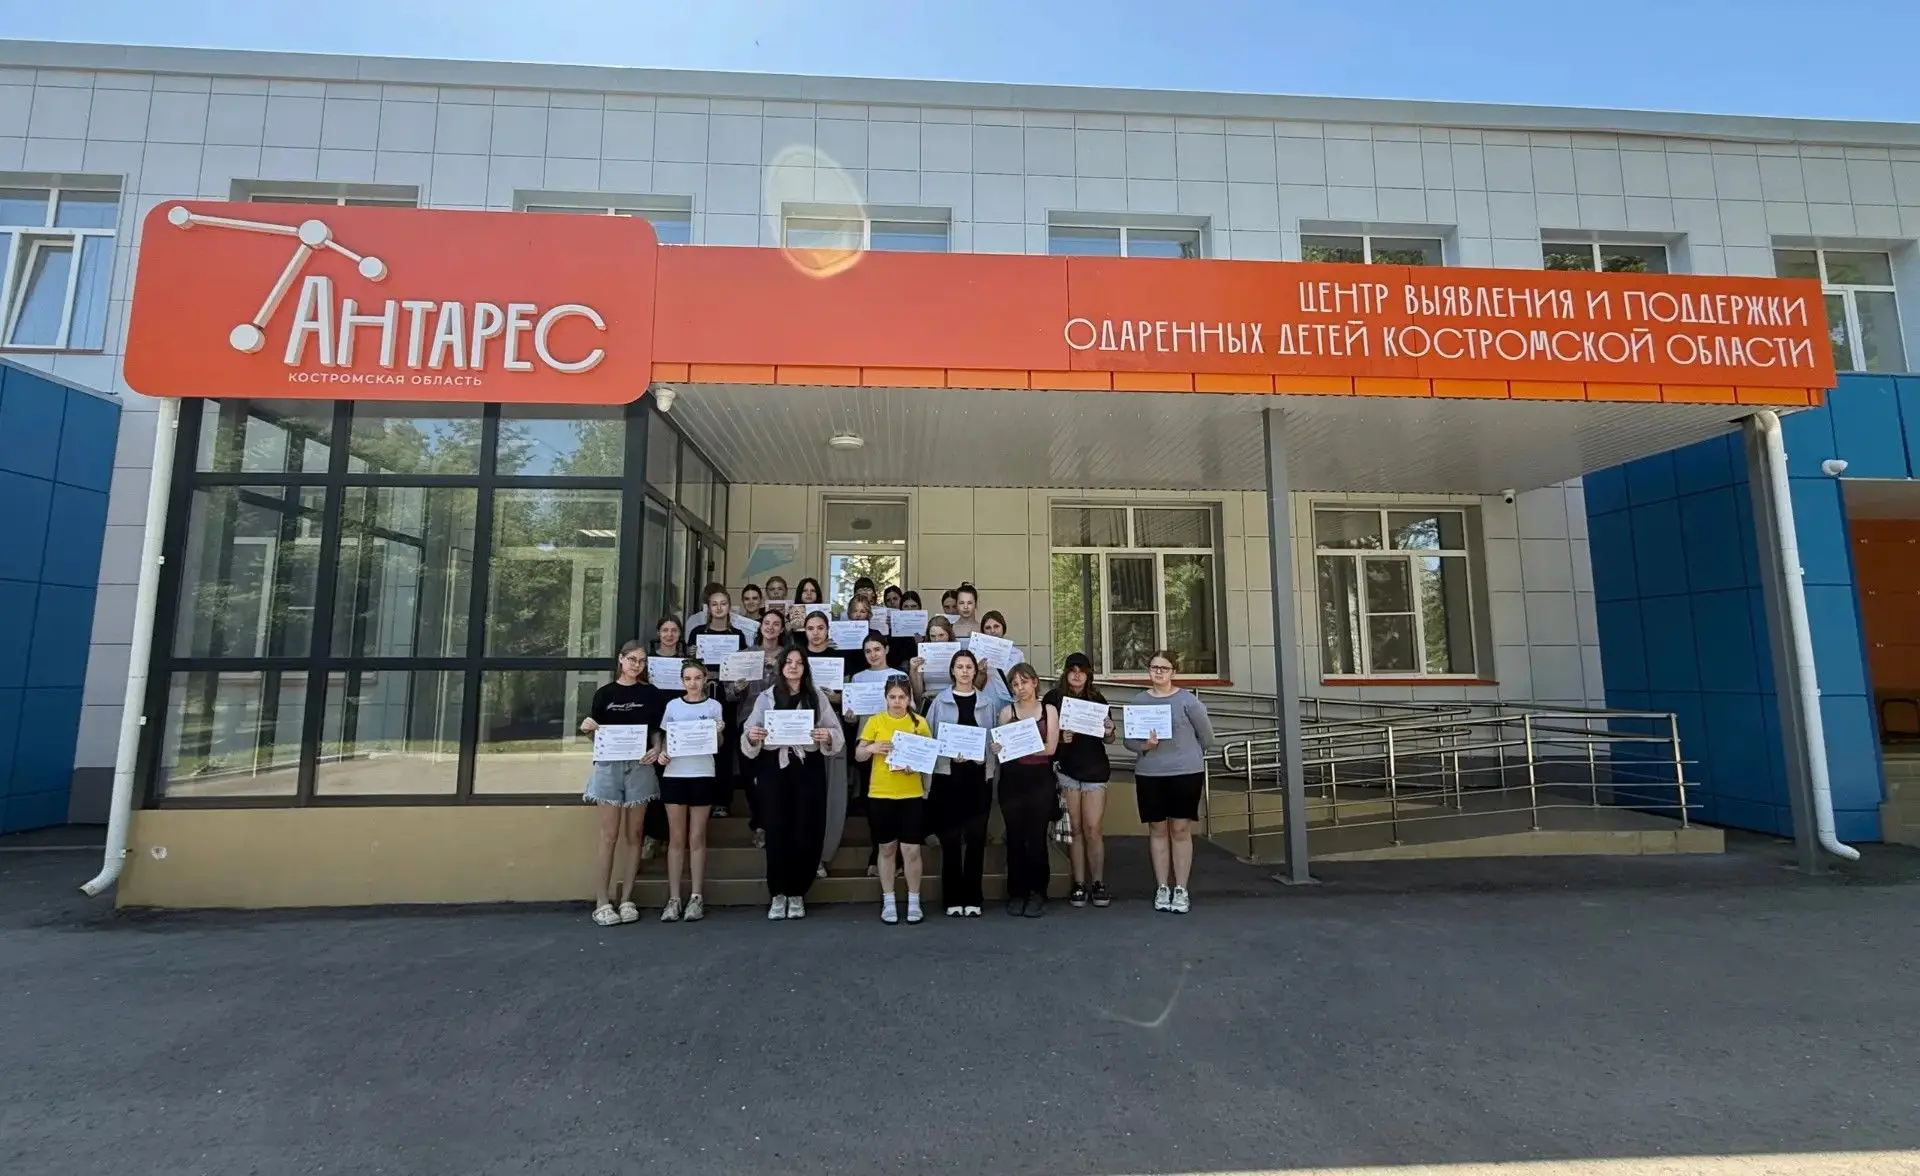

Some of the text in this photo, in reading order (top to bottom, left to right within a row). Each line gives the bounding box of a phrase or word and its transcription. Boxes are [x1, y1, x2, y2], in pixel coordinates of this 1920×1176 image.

[284, 275, 607, 374] АНТАРЕС
[1298, 281, 1808, 327] ЦЕНТР ВЫЯВЛЕНИЯ И ПОДДЕРЖКИ
[1064, 317, 1815, 368] ОДАРЕННЫХ ДЕТЕЙ КОСТРОМСКОЙ ОБЛАСТИ
[288, 372, 483, 387] КОСТРОМСКАЯ ОБЛАСТЬ
